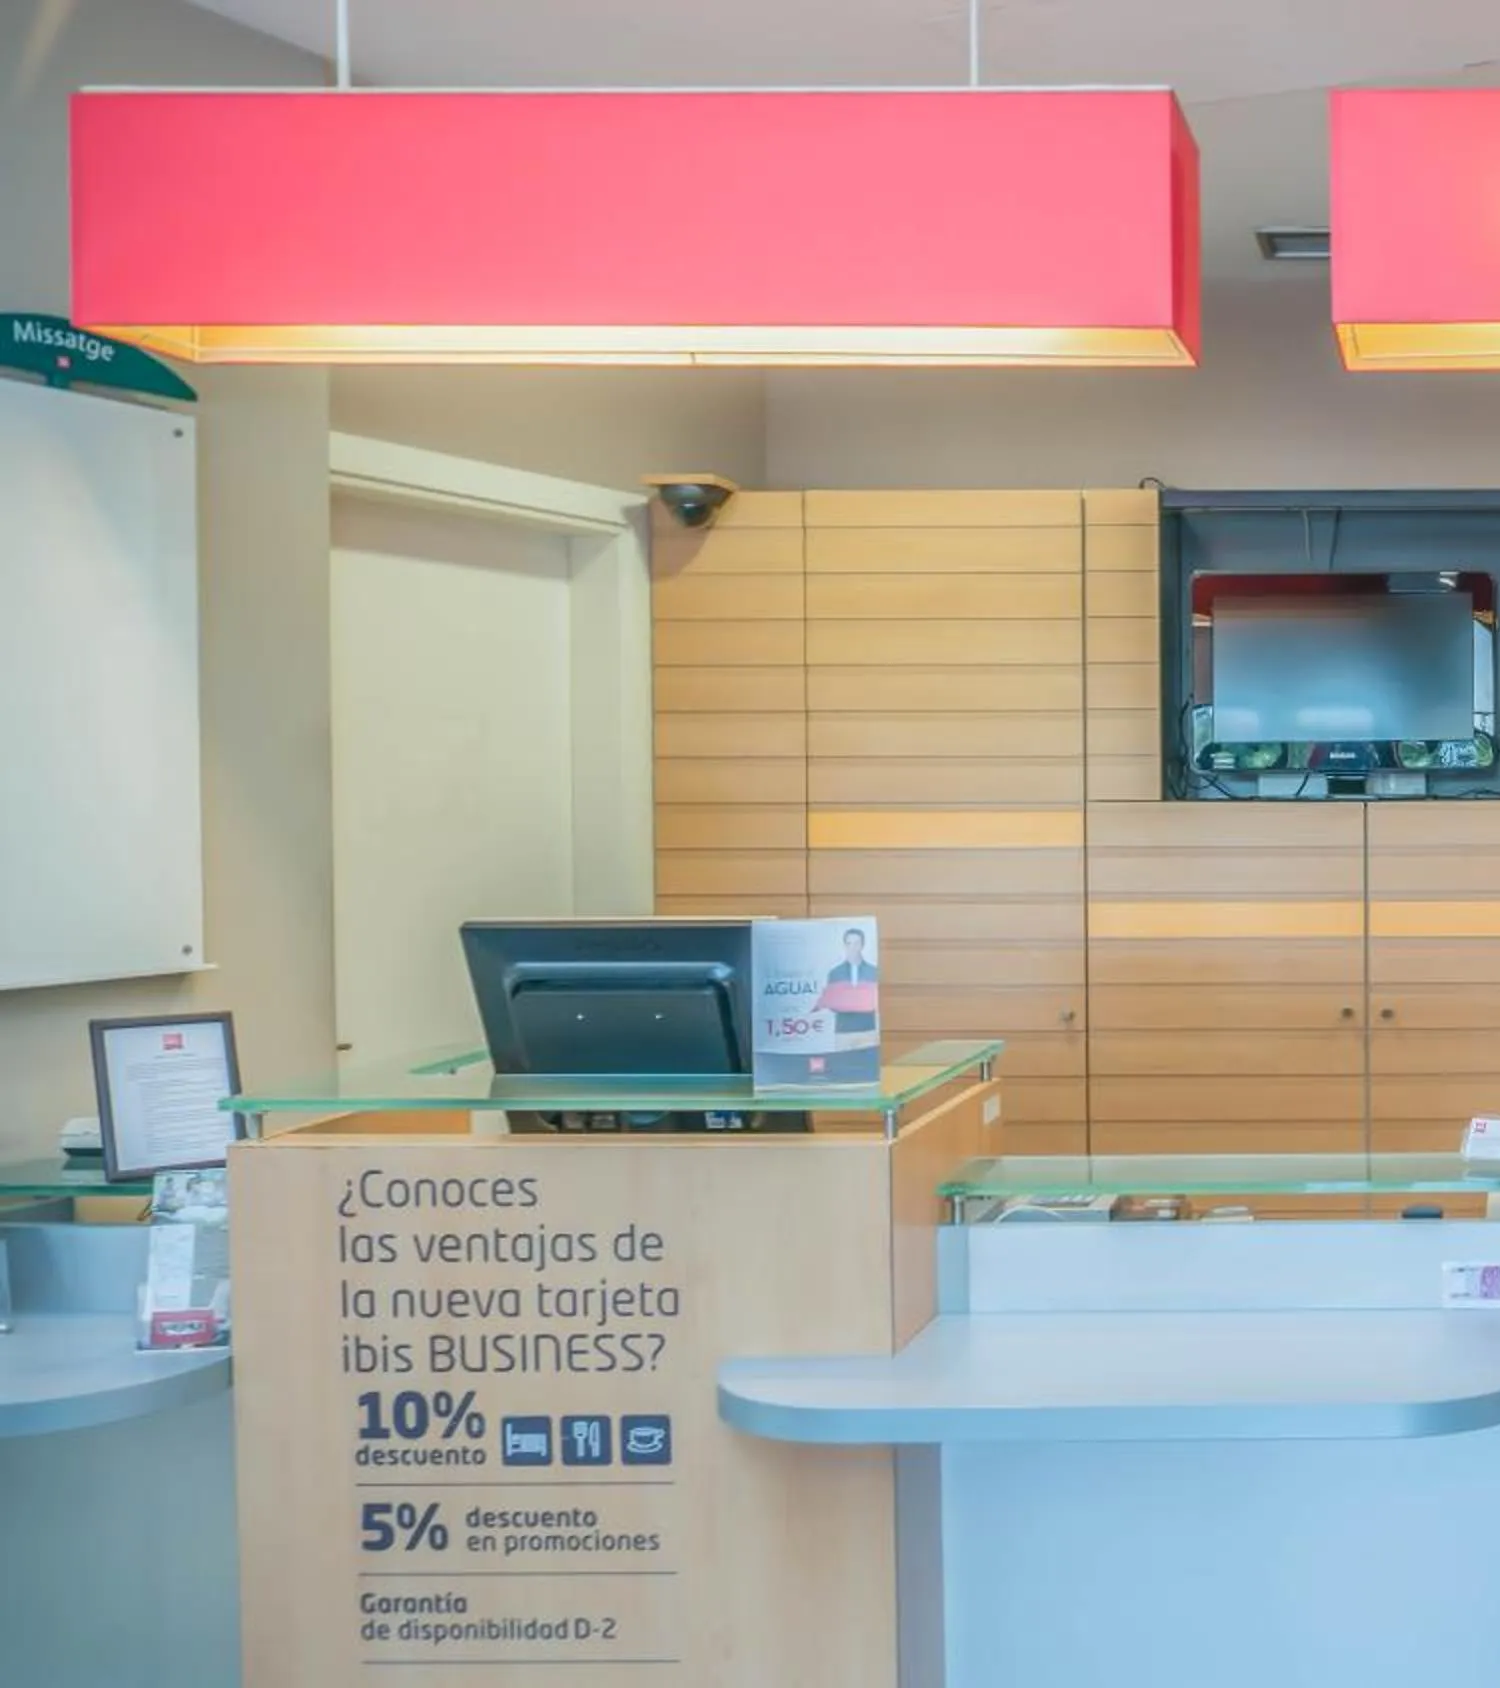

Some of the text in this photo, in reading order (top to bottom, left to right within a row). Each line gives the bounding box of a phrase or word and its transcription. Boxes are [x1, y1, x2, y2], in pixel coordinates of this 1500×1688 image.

[13, 320, 115, 361] Missatge
[764, 981, 817, 995] AGUA!
[338, 1170, 538, 1218] ¿Conoces
[340, 1224, 663, 1272] las ventajas de
[342, 1279, 679, 1326] la nueva tarjeta
[343, 1334, 665, 1373] ibis BUSINESS?
[358, 1391, 485, 1440] 10%
[355, 1444, 486, 1466] descuento
[362, 1503, 448, 1551] 5%
[466, 1507, 598, 1528] descuento
[467, 1530, 660, 1556] en promociones
[360, 1592, 467, 1614] Garantía
[360, 1618, 616, 1646] de disponibilidad D-2
